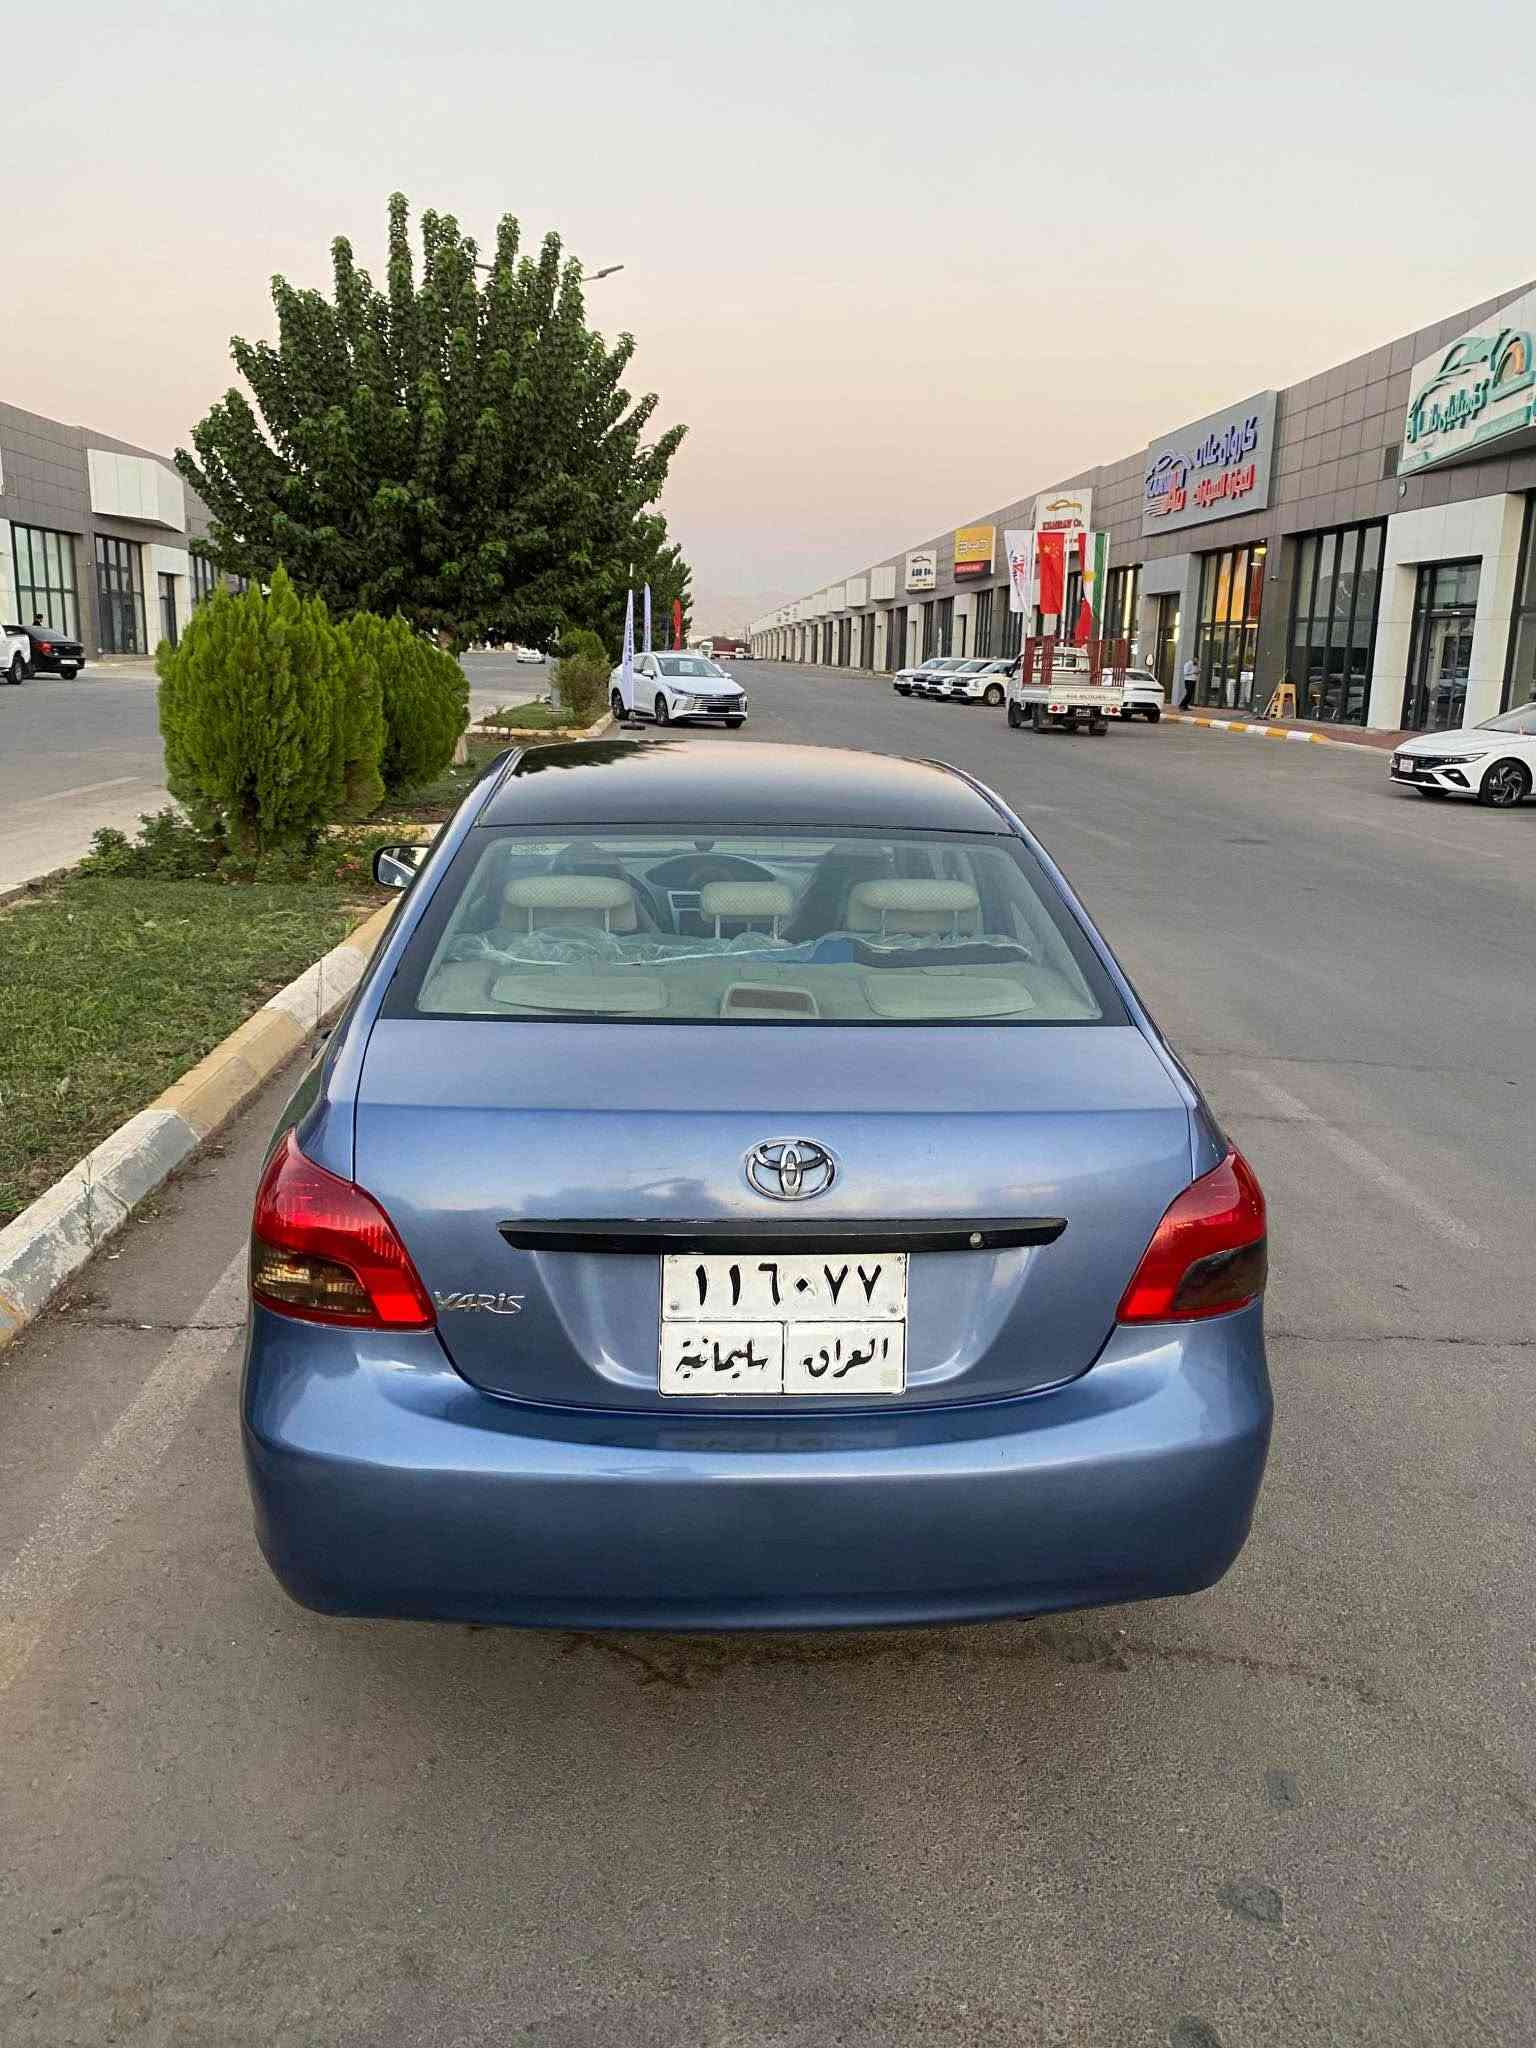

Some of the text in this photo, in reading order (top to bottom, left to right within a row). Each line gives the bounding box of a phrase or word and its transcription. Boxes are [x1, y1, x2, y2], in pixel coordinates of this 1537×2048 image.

[433, 1290, 525, 1315] YARIS
[695, 1262, 882, 1306] ١١٦٠٧٧
[675, 1337, 769, 1380] سليمانية
[802, 1336, 889, 1379] العراق
